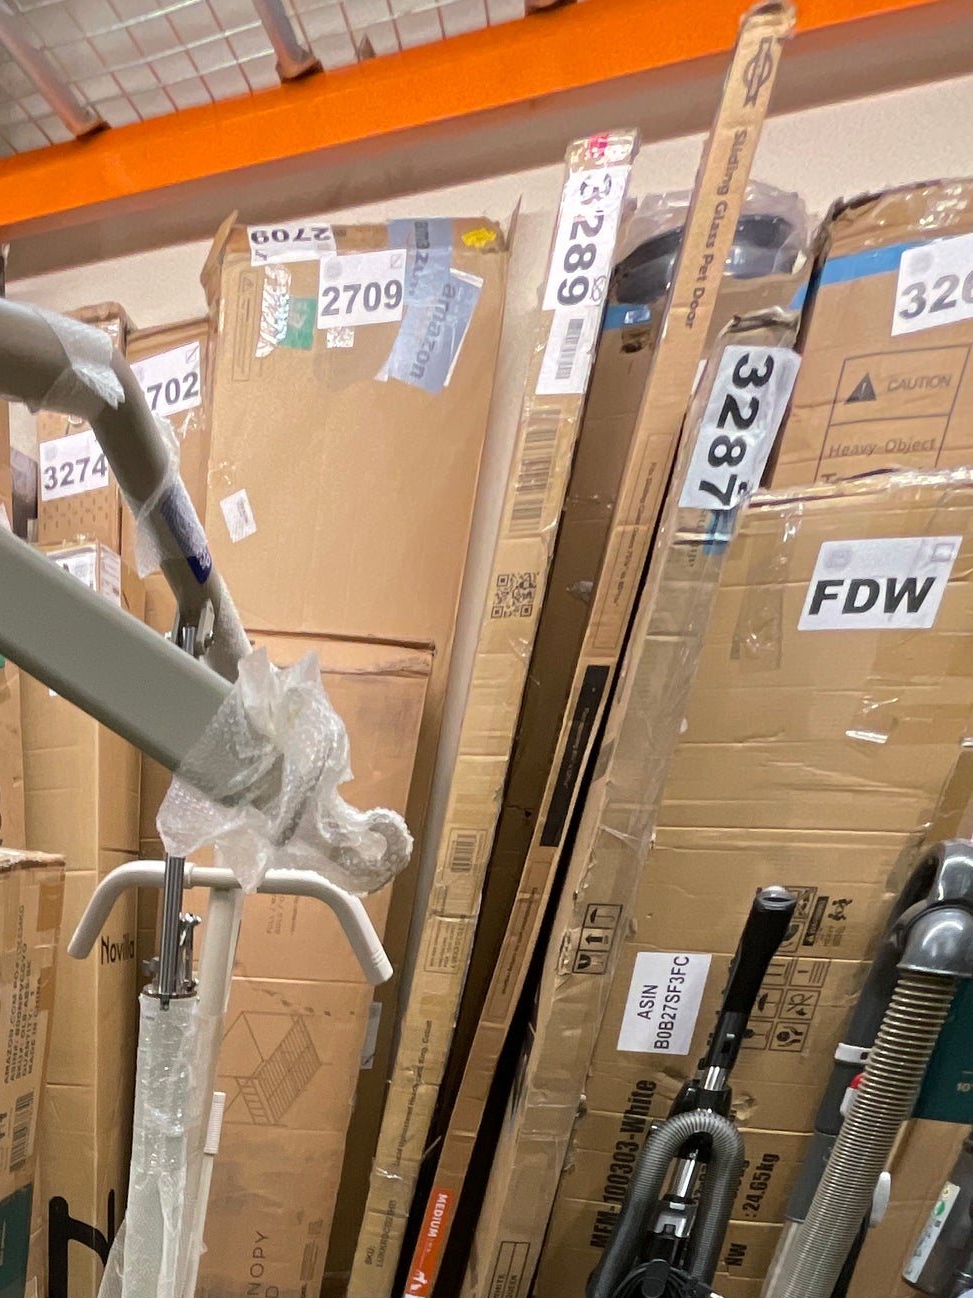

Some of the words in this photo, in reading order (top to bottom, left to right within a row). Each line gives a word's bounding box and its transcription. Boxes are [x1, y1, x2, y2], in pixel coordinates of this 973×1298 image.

[717, 128, 747, 194] Sliding
[250, 226, 332, 244] 2709
[557, 173, 612, 306] 3289
[706, 199, 729, 250] Glass
[696, 253, 715, 283] Pet
[321, 279, 404, 317] 2709
[685, 286, 706, 330] Door
[410, 283, 456, 379] amazon
[146, 371, 199, 412] 702
[887, 374, 953, 392] CAUTION
[698, 353, 775, 507] 3287
[829, 441, 877, 458] Heavy
[884, 437, 937, 453] Object
[43, 453, 108, 491] 3274
[808, 576, 938, 616] FDW
[637, 984, 659, 1020] ASIN
[654, 956, 690, 1050] B0B27SF3FC
[428, 1193, 449, 1238] MEDIUM
